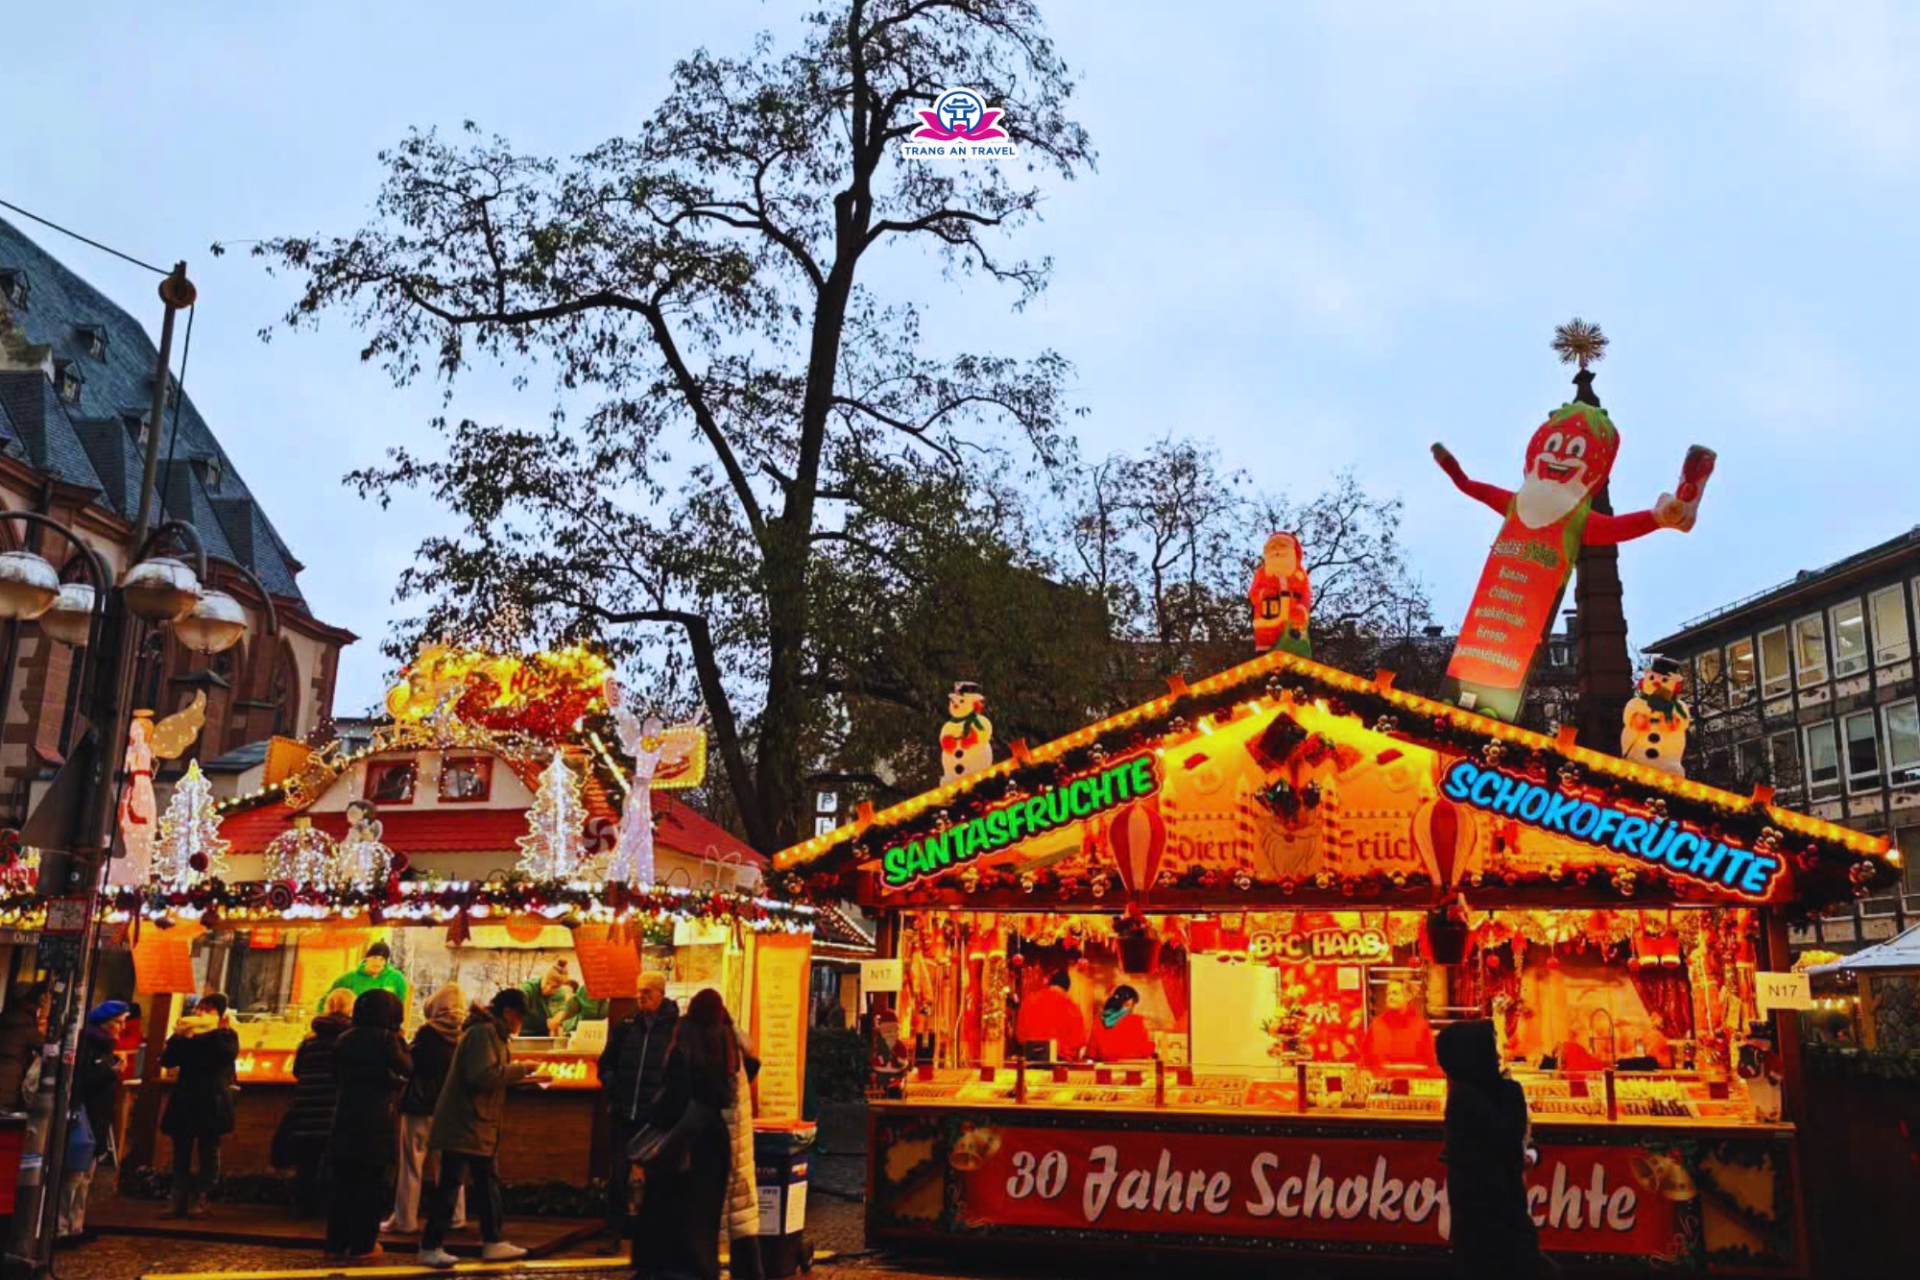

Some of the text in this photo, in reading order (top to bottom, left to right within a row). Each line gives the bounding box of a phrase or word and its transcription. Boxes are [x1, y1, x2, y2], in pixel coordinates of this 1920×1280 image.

[1445, 762, 1776, 892] SCHOKOFRÜCHTE
[1254, 931, 1382, 958] B+C HAAS
[870, 969, 892, 979] N17
[1768, 984, 1798, 997] N17
[1006, 1149, 1068, 1199] 30
[1082, 1145, 1232, 1222] Jahre
